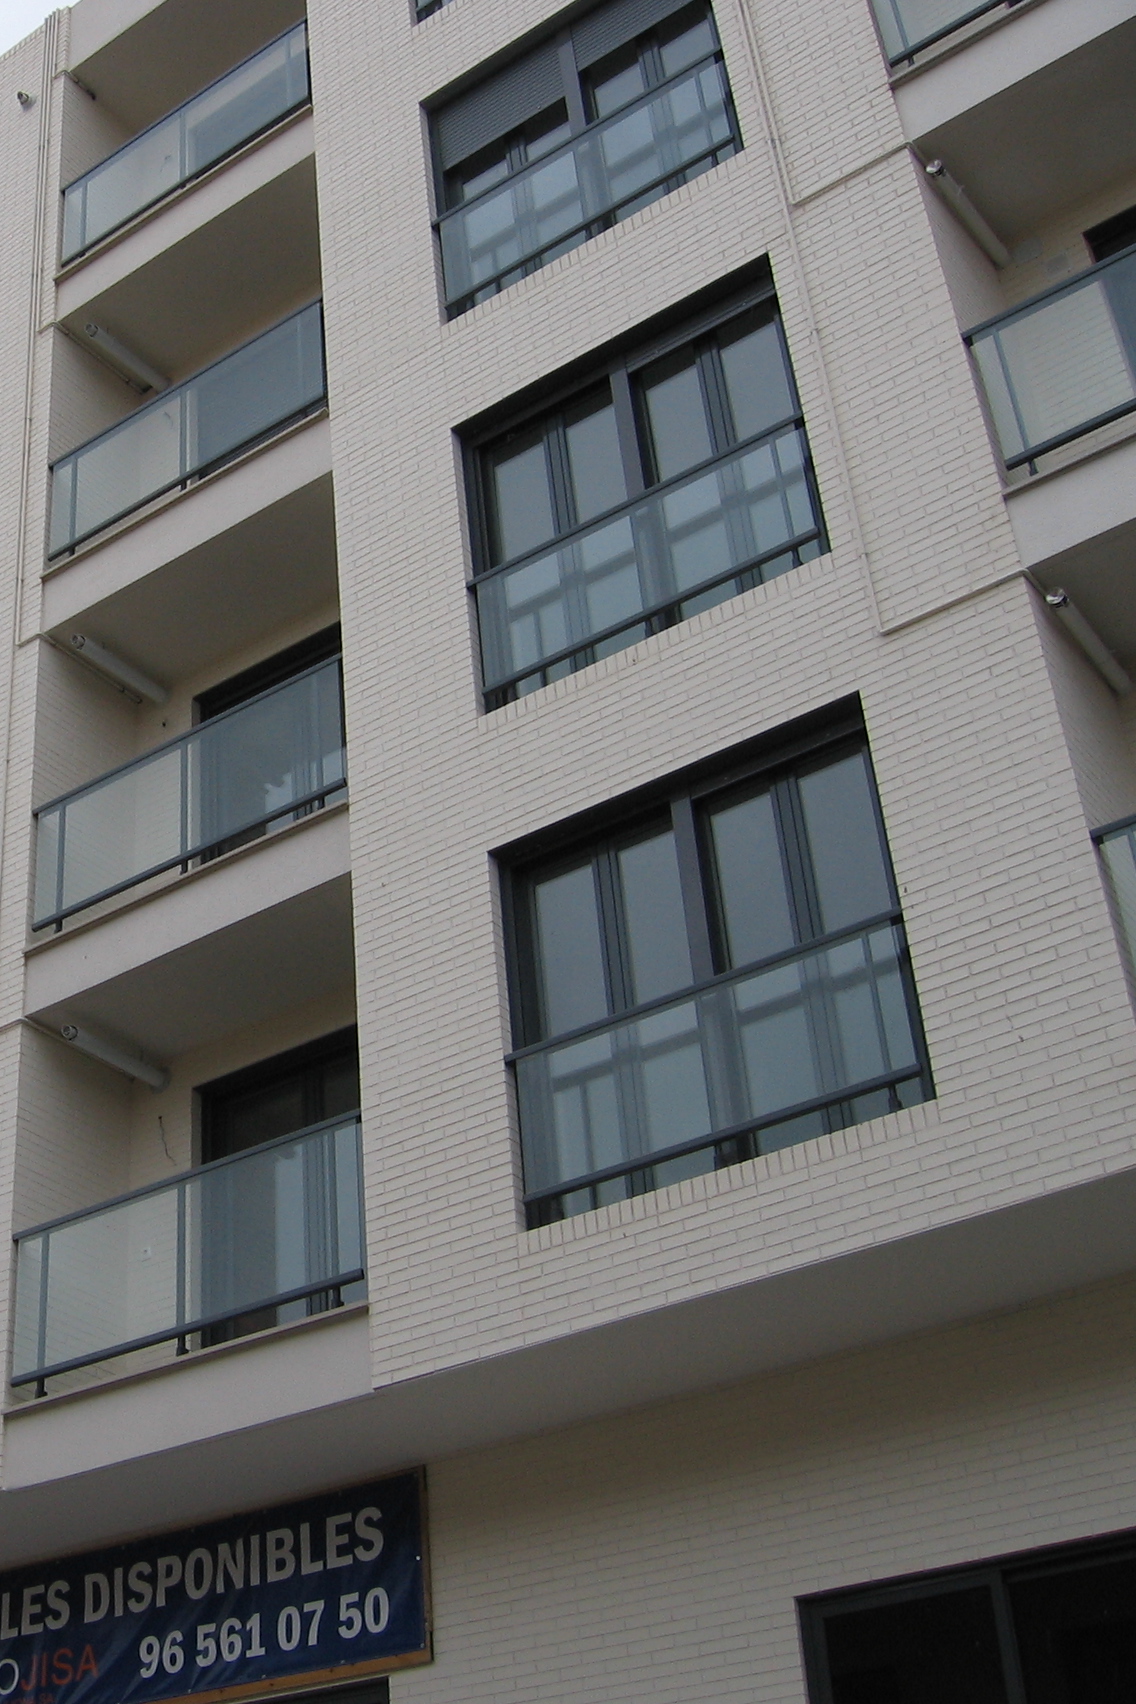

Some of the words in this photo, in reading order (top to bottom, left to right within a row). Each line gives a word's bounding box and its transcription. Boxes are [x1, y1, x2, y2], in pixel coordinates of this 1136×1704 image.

[84, 1507, 384, 1623] DISPONIBLES
[139, 1630, 185, 1679] 96
[196, 1613, 266, 1668] 561
[277, 1600, 326, 1651] 07
[338, 1587, 390, 1640] 50
